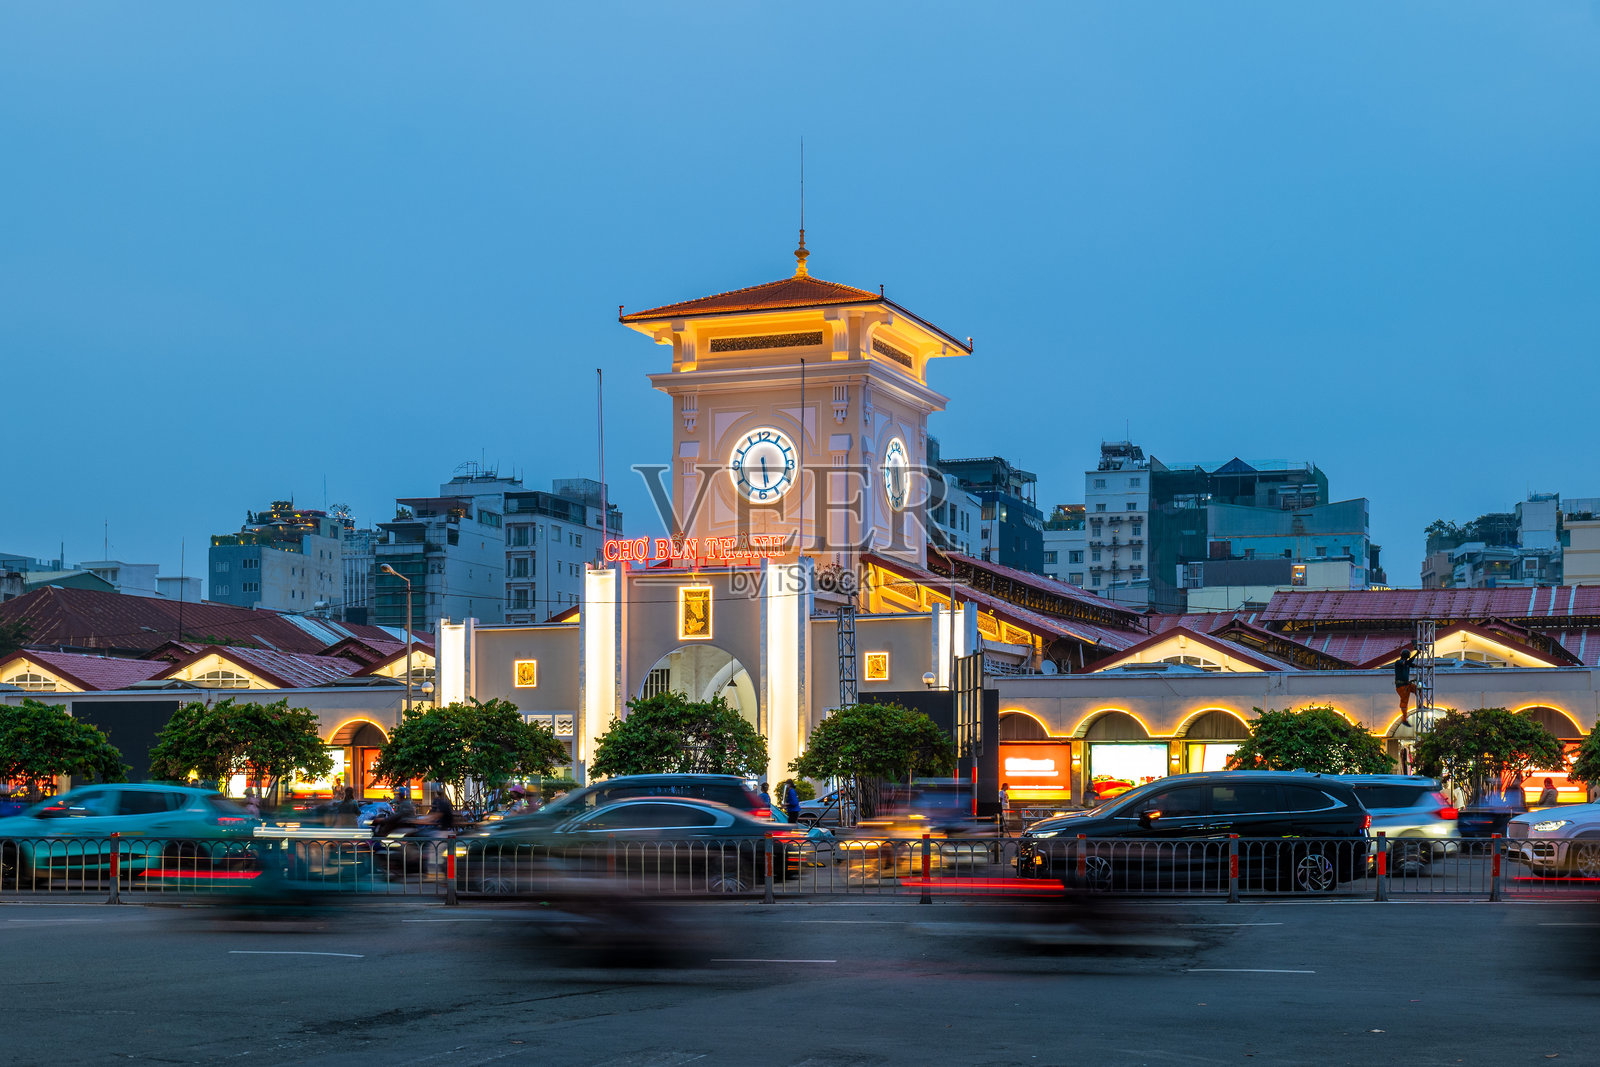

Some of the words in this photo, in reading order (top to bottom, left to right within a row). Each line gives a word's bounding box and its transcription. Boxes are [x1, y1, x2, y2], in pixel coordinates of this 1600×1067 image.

[757, 431, 771, 441] 12
[732, 460, 741, 471] 9
[787, 459, 795, 470] 3
[759, 490, 768, 500] 6
[604, 536, 649, 564] CHỢ
[705, 532, 786, 560] THÀNH
